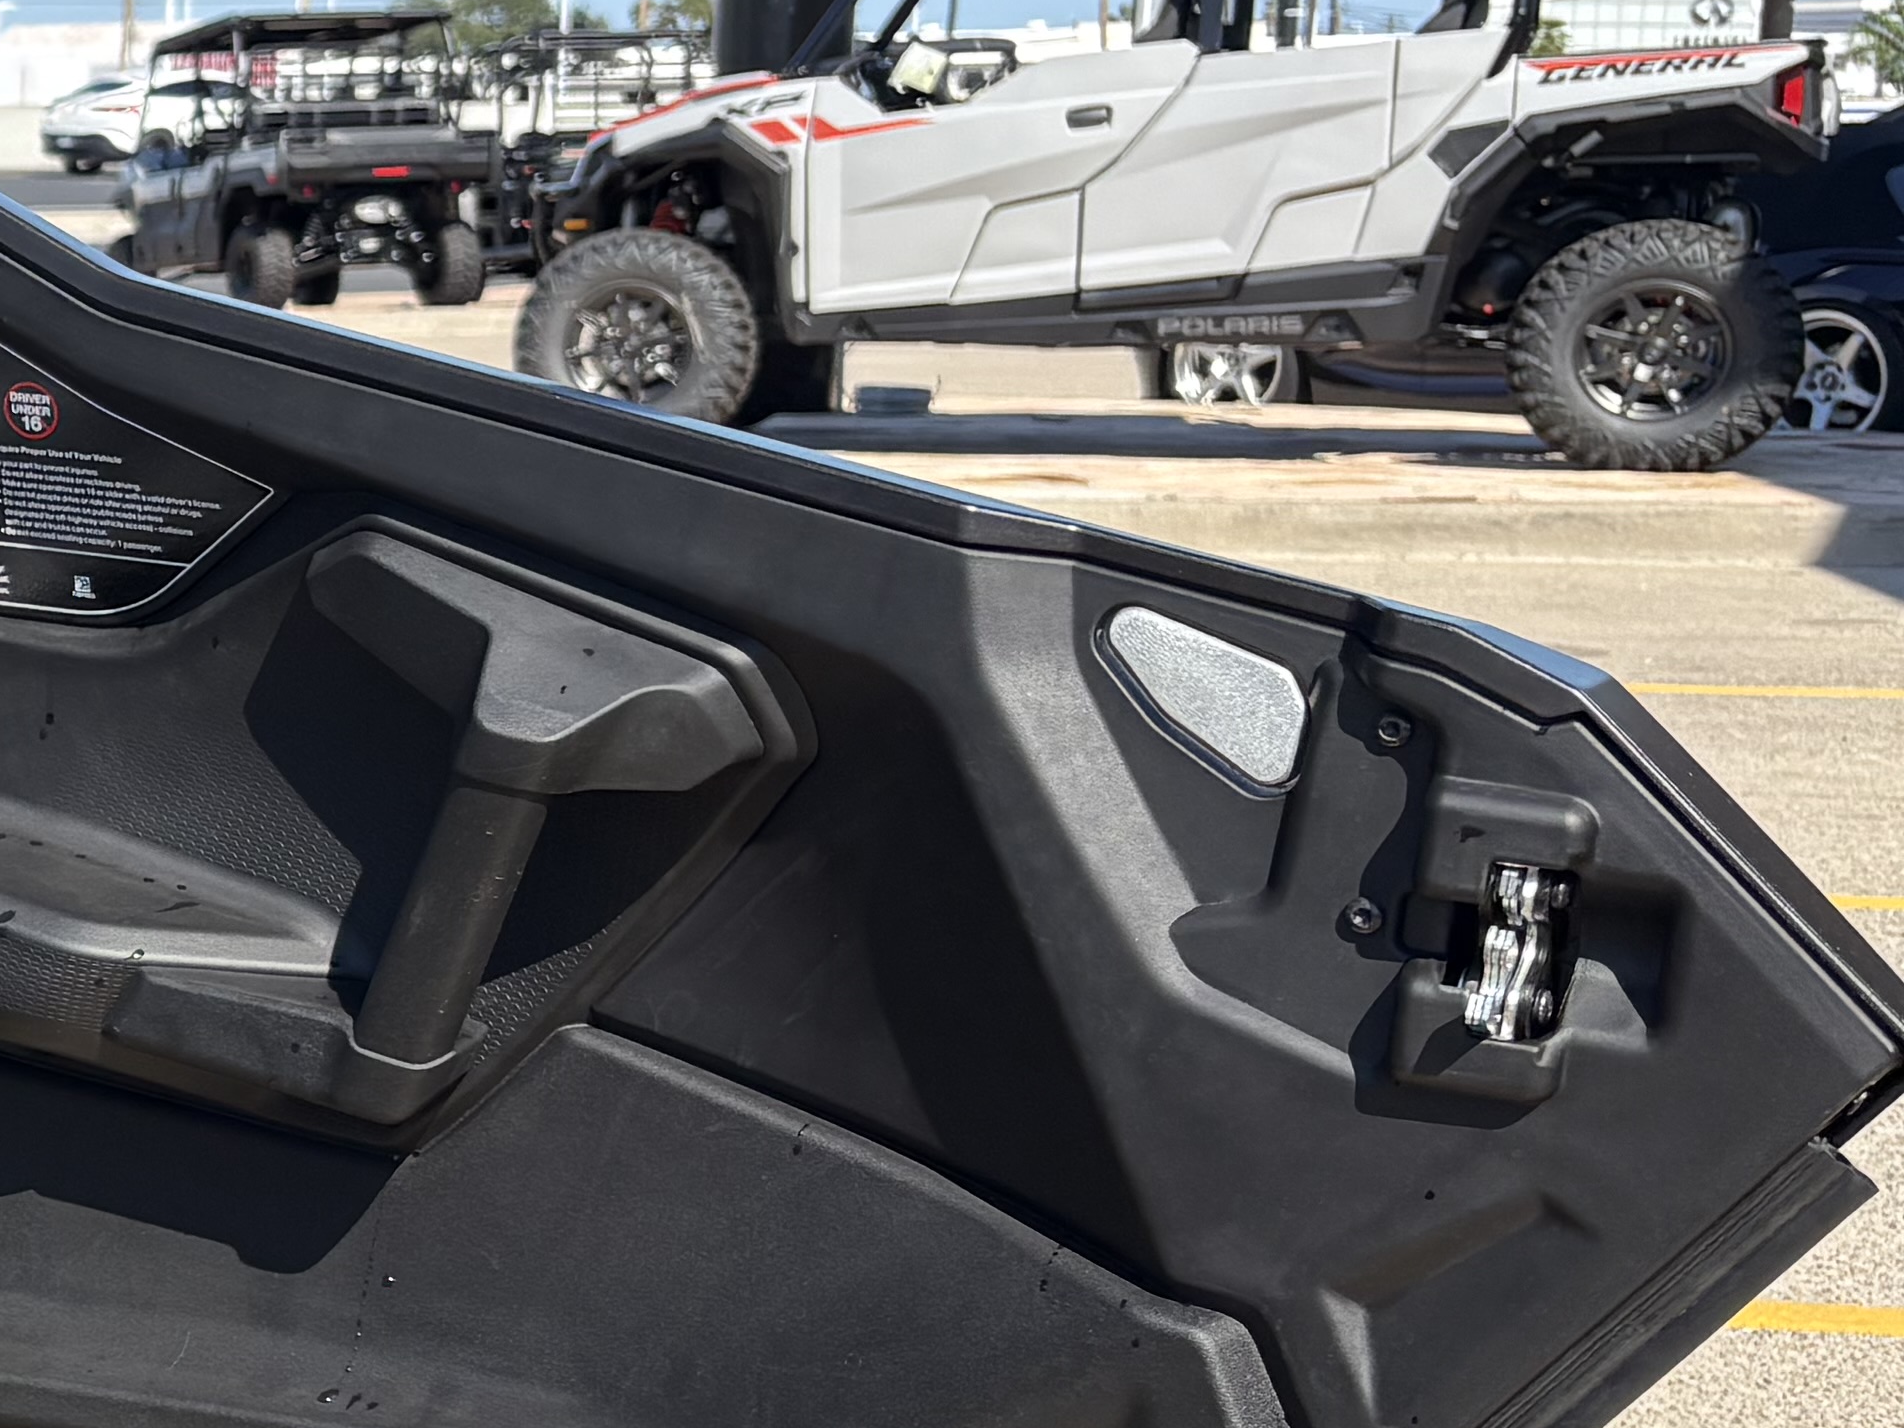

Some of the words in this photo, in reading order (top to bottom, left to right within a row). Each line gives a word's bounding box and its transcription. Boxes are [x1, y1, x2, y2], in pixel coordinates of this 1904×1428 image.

[1537, 51, 1745, 84] GENERAL
[1157, 315, 1304, 337] POLARIS
[9, 391, 50, 405] DRIVER
[11, 403, 51, 417] UNDER
[21, 415, 42, 432] 16
